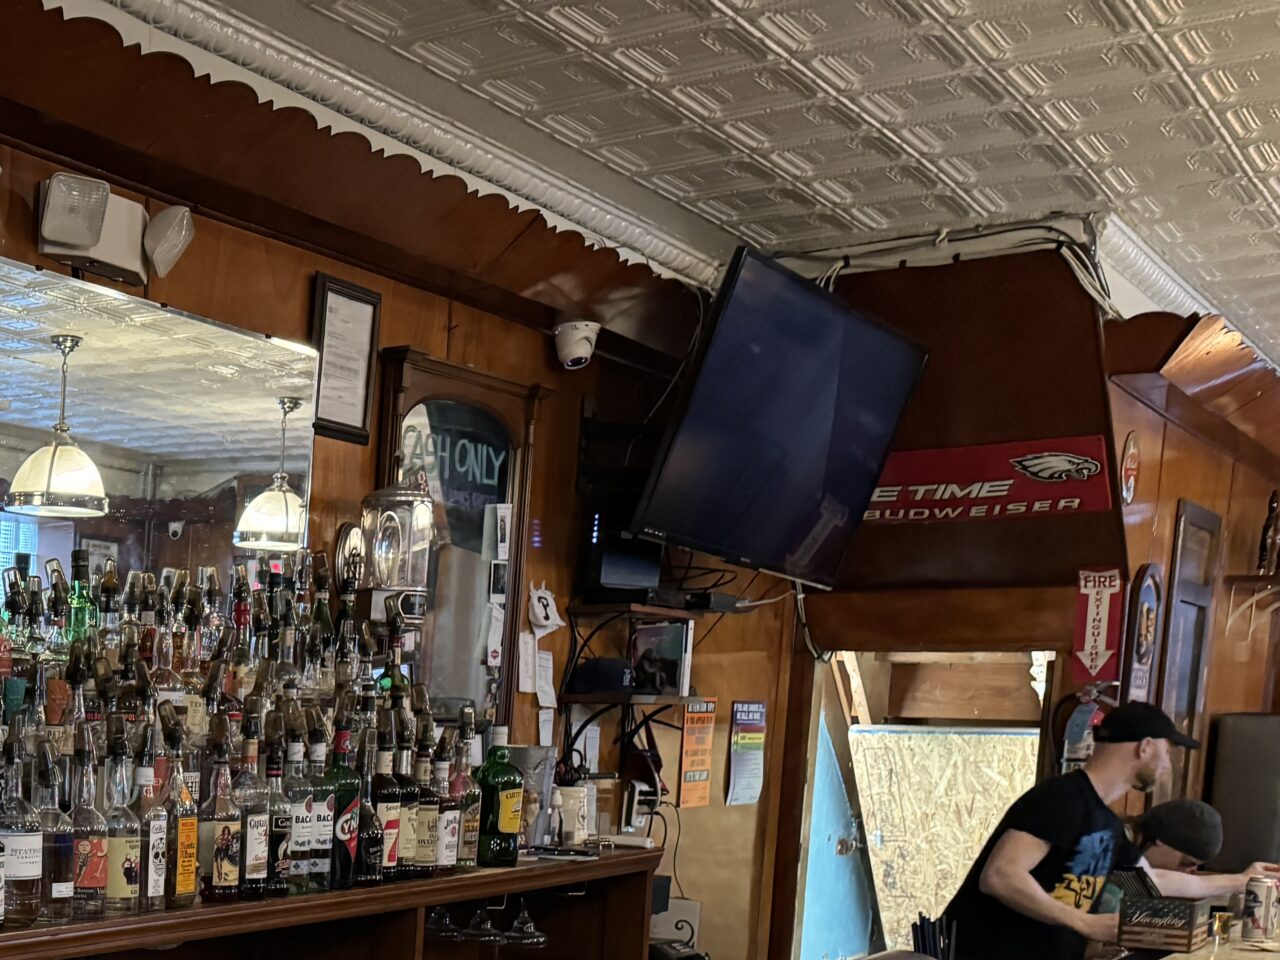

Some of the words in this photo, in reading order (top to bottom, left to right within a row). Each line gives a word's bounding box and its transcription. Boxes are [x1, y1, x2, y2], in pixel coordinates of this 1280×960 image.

[402, 425, 451, 481] CASH
[455, 440, 506, 486] ONLY
[907, 480, 1014, 500] TIME
[863, 498, 1081, 521] BUDWEISER
[1084, 574, 1117, 589] FIRE
[1089, 590, 1104, 670] EXTINGUISHER
[1127, 911, 1186, 927] Yuengling
